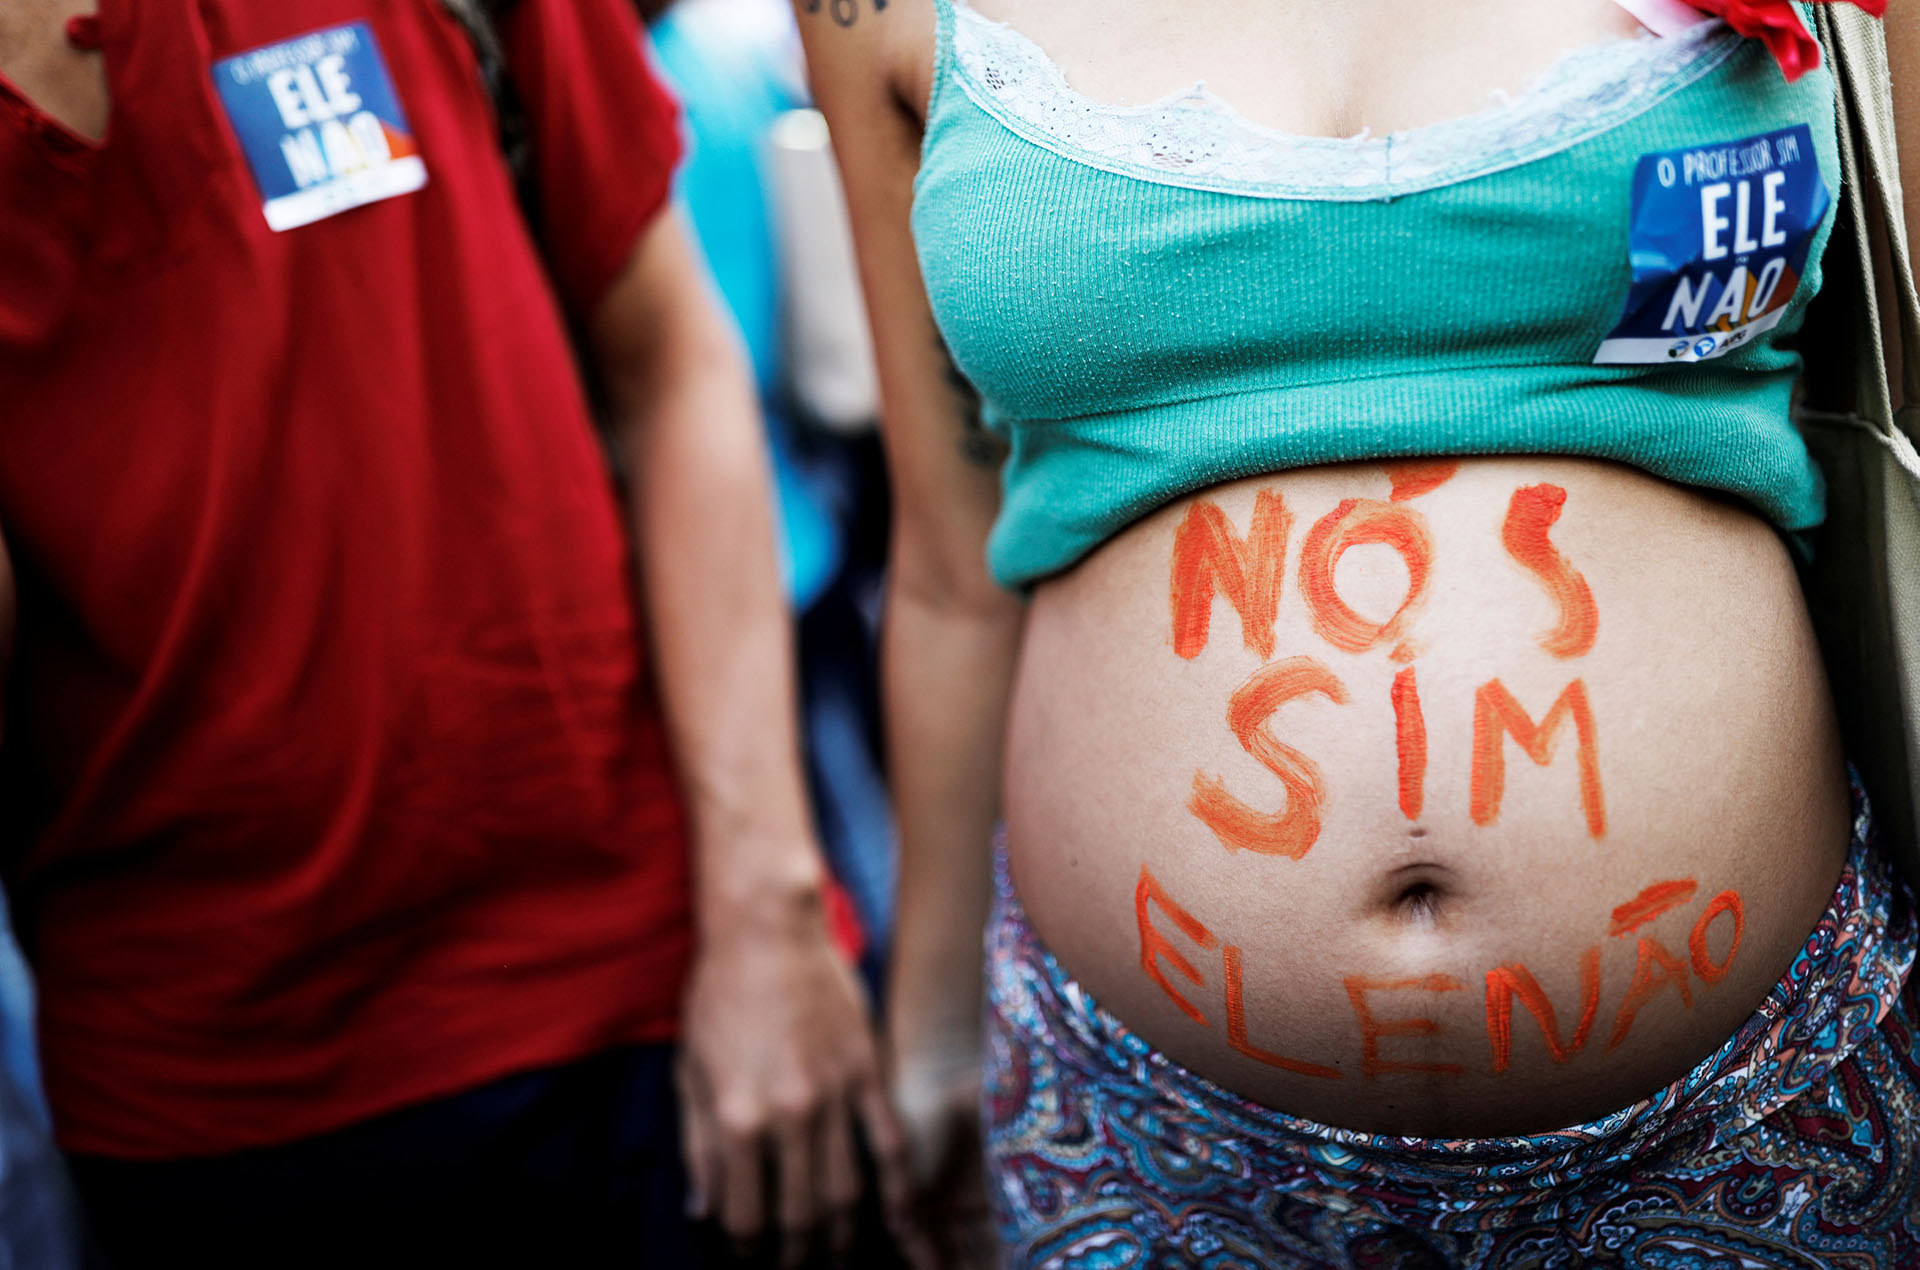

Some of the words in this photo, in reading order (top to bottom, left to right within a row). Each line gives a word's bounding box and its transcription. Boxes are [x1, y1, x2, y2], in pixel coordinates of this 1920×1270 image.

[266, 54, 362, 130] ELE
[1657, 157, 1676, 188] O
[1683, 138, 1775, 187] PROFESSOR
[1776, 134, 1801, 166] SIM
[1701, 171, 1786, 261] ELE
[1661, 256, 1786, 331] NÃO
[1168, 459, 1600, 660] NÓS
